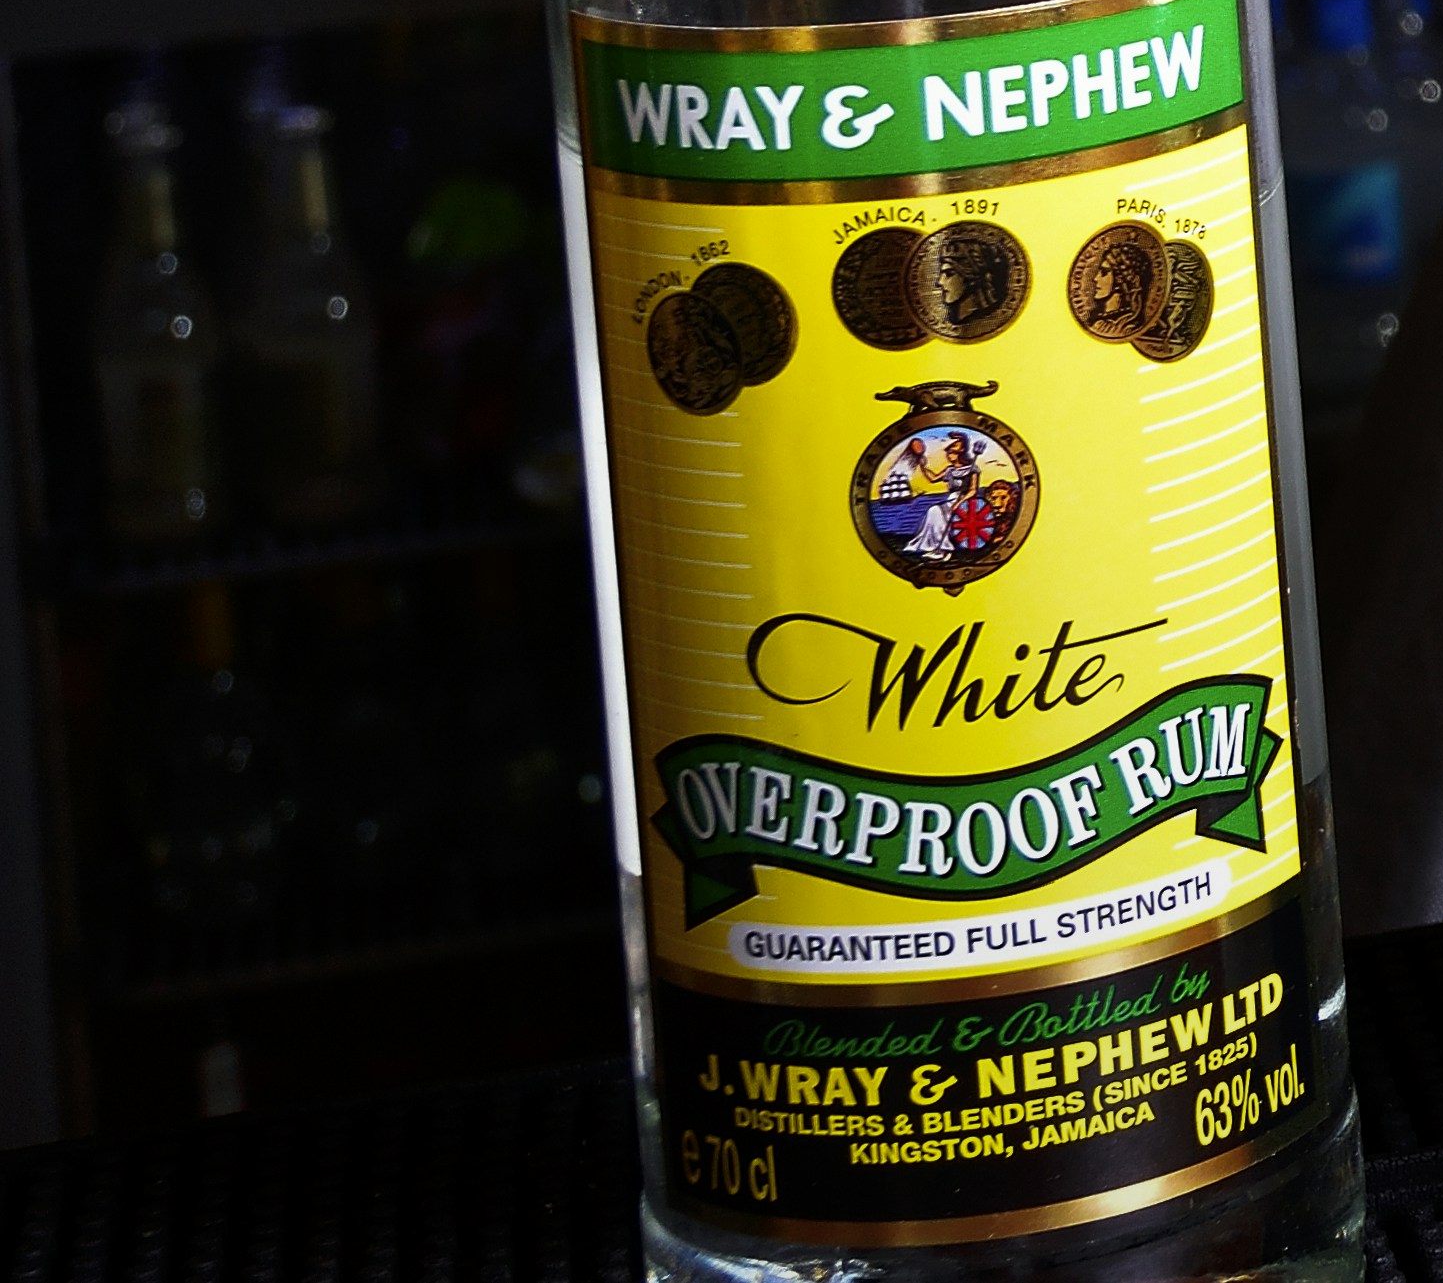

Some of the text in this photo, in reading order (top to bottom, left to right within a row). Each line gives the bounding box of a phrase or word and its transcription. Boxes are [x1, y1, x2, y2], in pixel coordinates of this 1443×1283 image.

[617, 25, 1206, 152] WRAY & NEPHEW
[690, 240, 730, 266] 1862
[951, 199, 1000, 216] 1891
[855, 416, 1037, 506] TRADE MARK
[746, 612, 1169, 733] White
[676, 701, 1252, 878] OVERPROOF RUM
[744, 872, 1212, 963] GUARANTEED FULL STRENGTH
[764, 964, 1212, 1060] Blended & Bottled by
[909, 1063, 958, 1105] &
[978, 1003, 1212, 1099] NEPHEW
[1222, 972, 1285, 1038] LTD
[734, 1033, 1258, 1138] DISTILLERS & BLENDERS (SINCE 1825)
[850, 1105, 1156, 1165] KINGSTON, JAMAICA
[1194, 1043, 1306, 1148] 63% vol.
